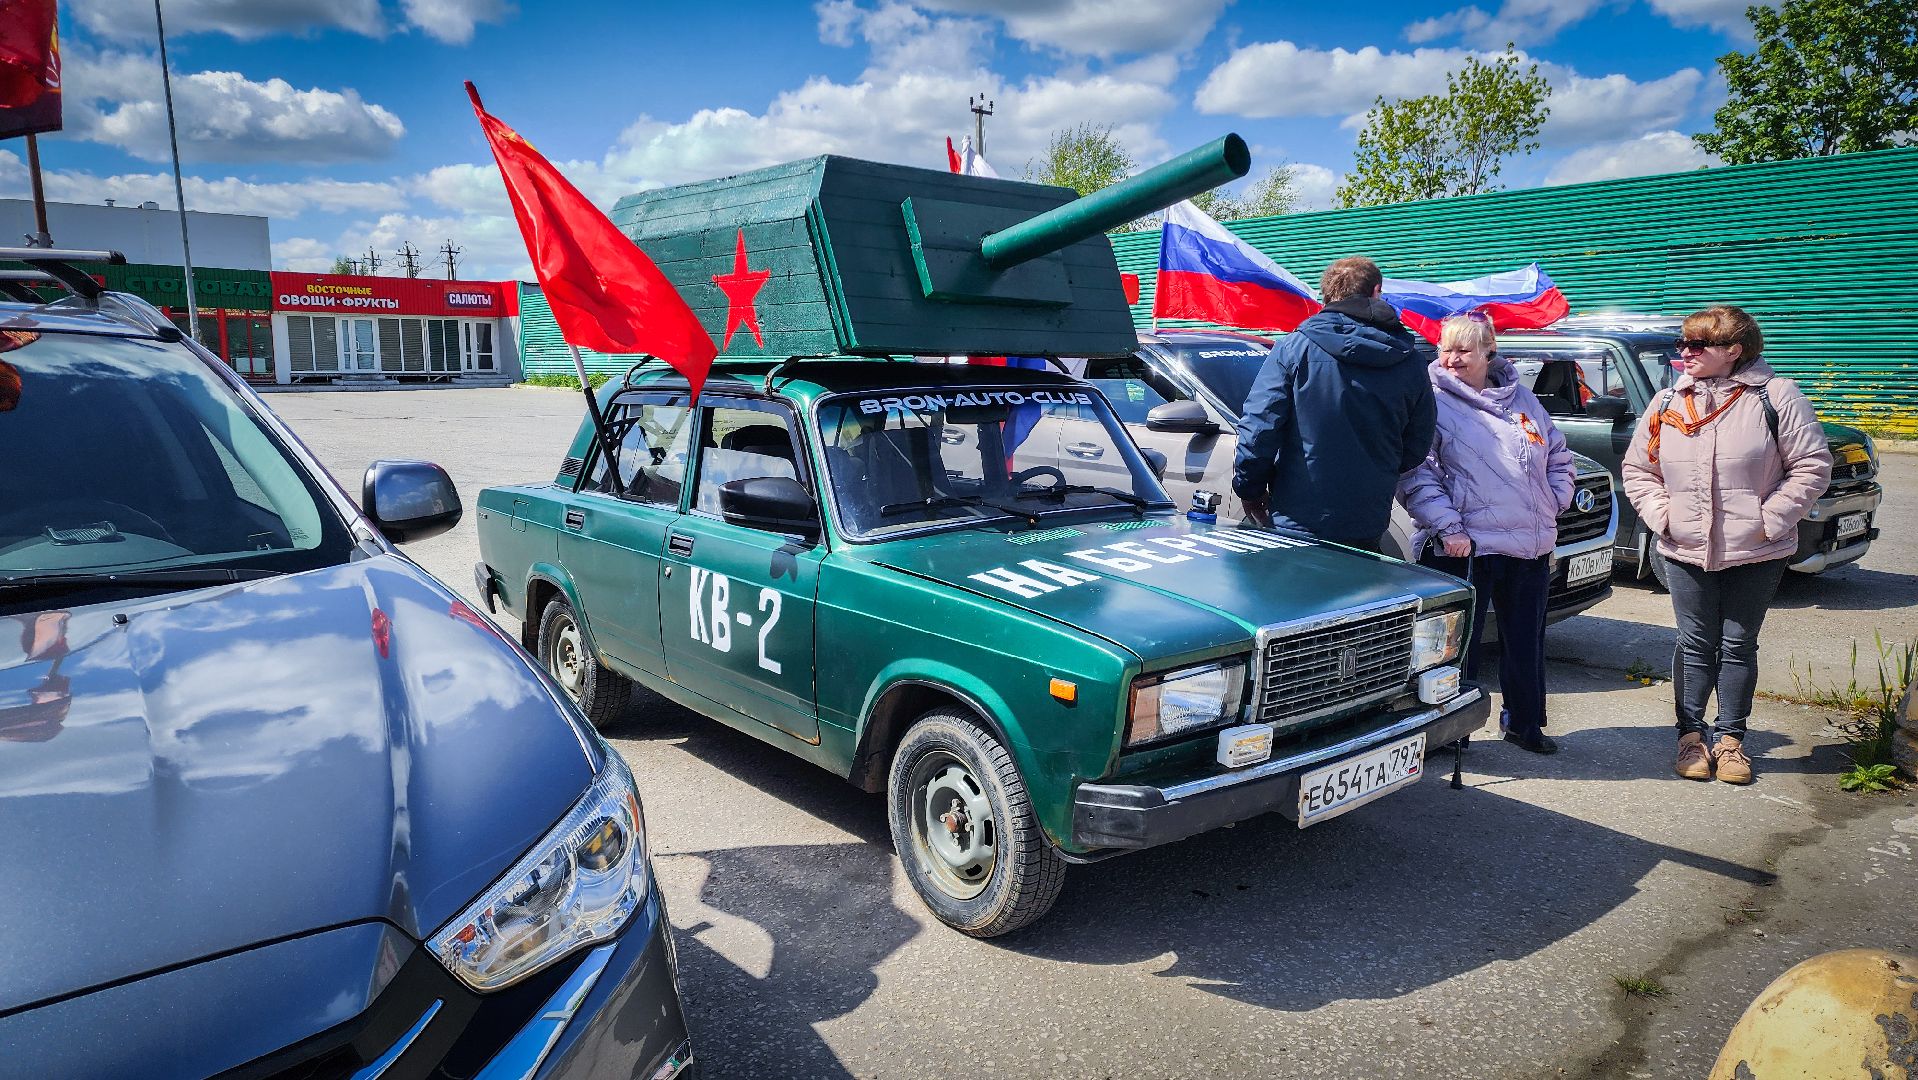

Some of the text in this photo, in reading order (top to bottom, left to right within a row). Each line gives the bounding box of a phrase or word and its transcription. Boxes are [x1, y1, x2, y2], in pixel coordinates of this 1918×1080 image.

[306, 284, 372, 295] ВОСТОЧНЫЕ
[449, 293, 492, 306] САЛЮТЫ
[859, 391, 1093, 415] BRON-AUTO-CLUB
[967, 559, 1103, 599] НА
[689, 566, 783, 675] КВ-2
